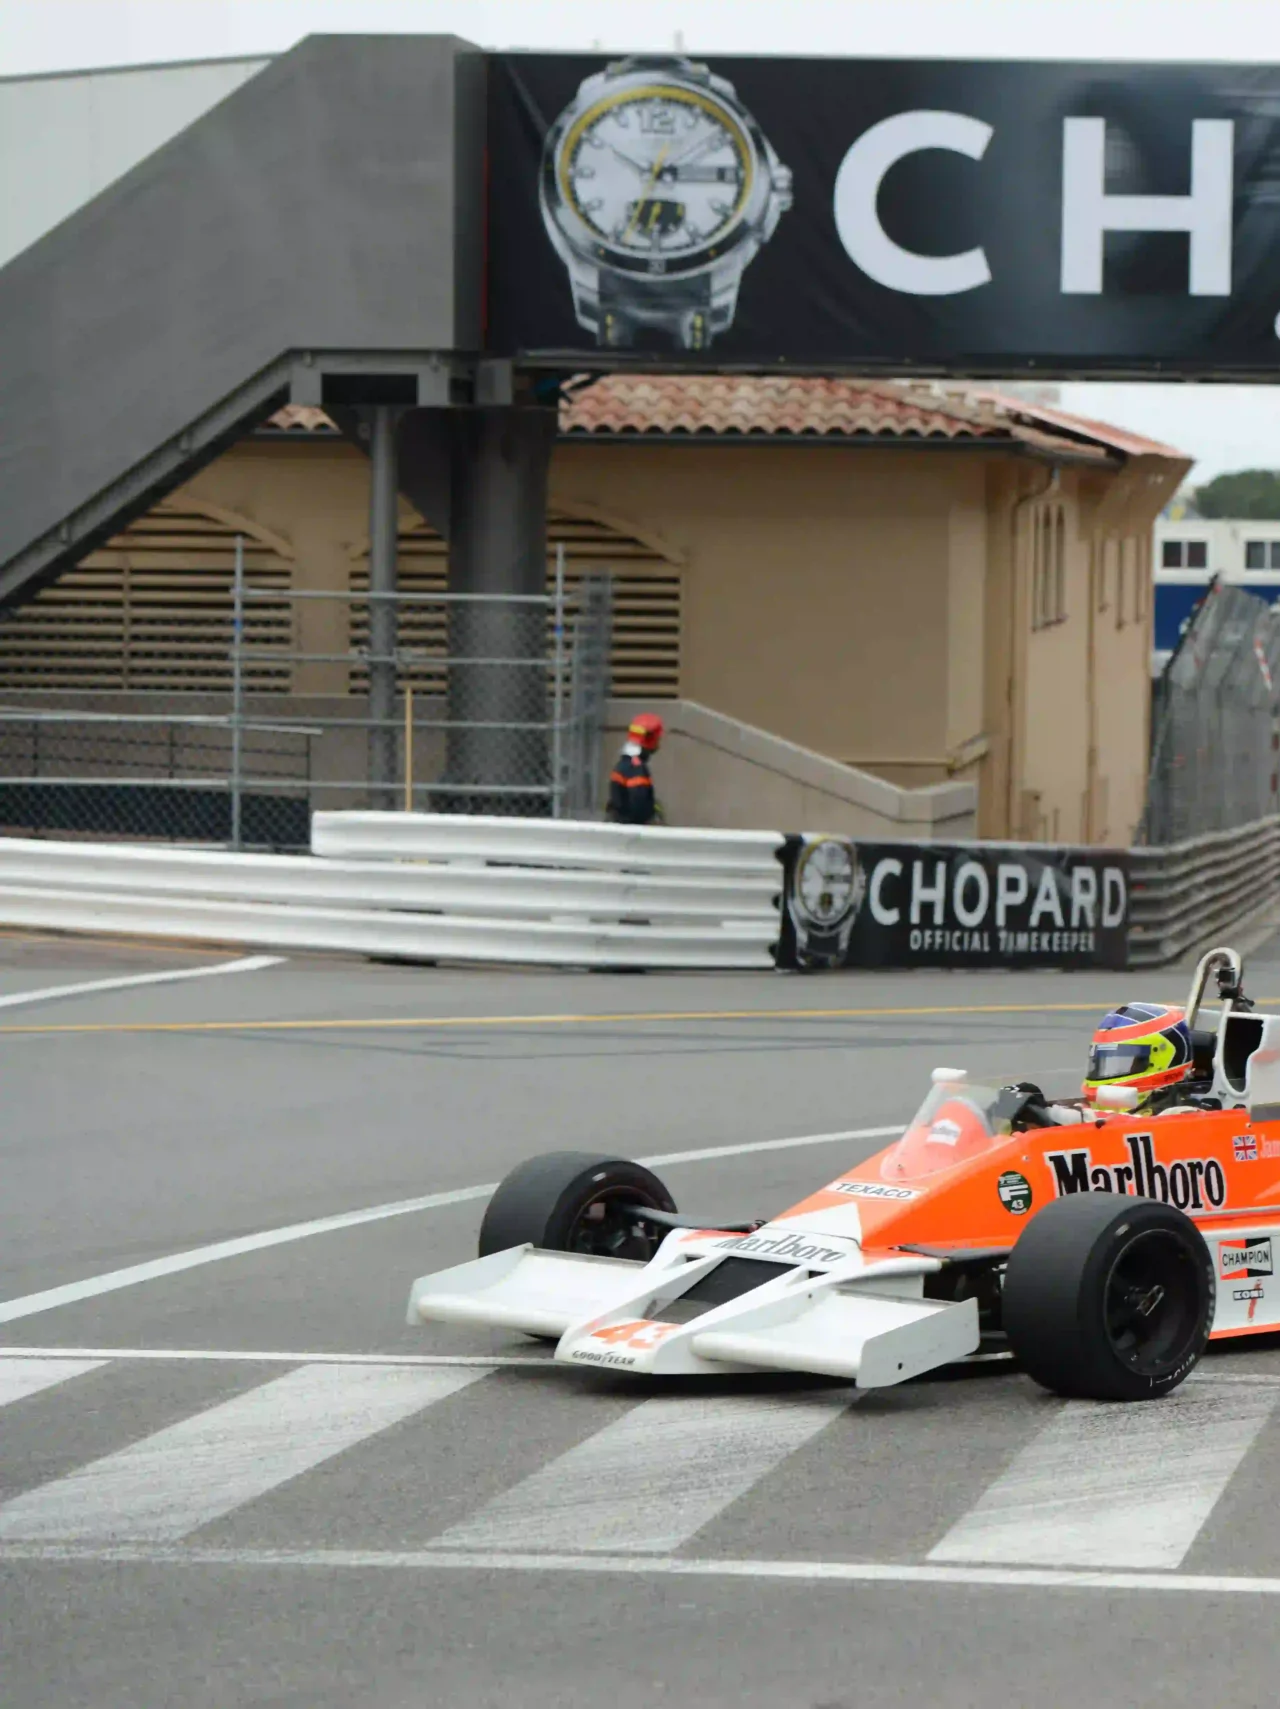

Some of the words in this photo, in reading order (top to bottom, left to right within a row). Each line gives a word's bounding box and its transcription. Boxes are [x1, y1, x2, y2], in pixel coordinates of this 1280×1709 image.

[869, 858, 1127, 928] CHOPARD
[909, 929, 990, 952] OFFICIAL
[998, 931, 1095, 953] TIMEKEEPER
[1048, 1135, 1225, 1210] Marlboro
[835, 1182, 913, 1198] TEXACO
[712, 1233, 847, 1263] Marlboro
[1222, 1250, 1270, 1267] CHAMPION
[1233, 1289, 1264, 1300] KONI
[590, 1319, 683, 1349] 43
[572, 1350, 601, 1362] GOOD
[607, 1353, 636, 1366] YEAR
